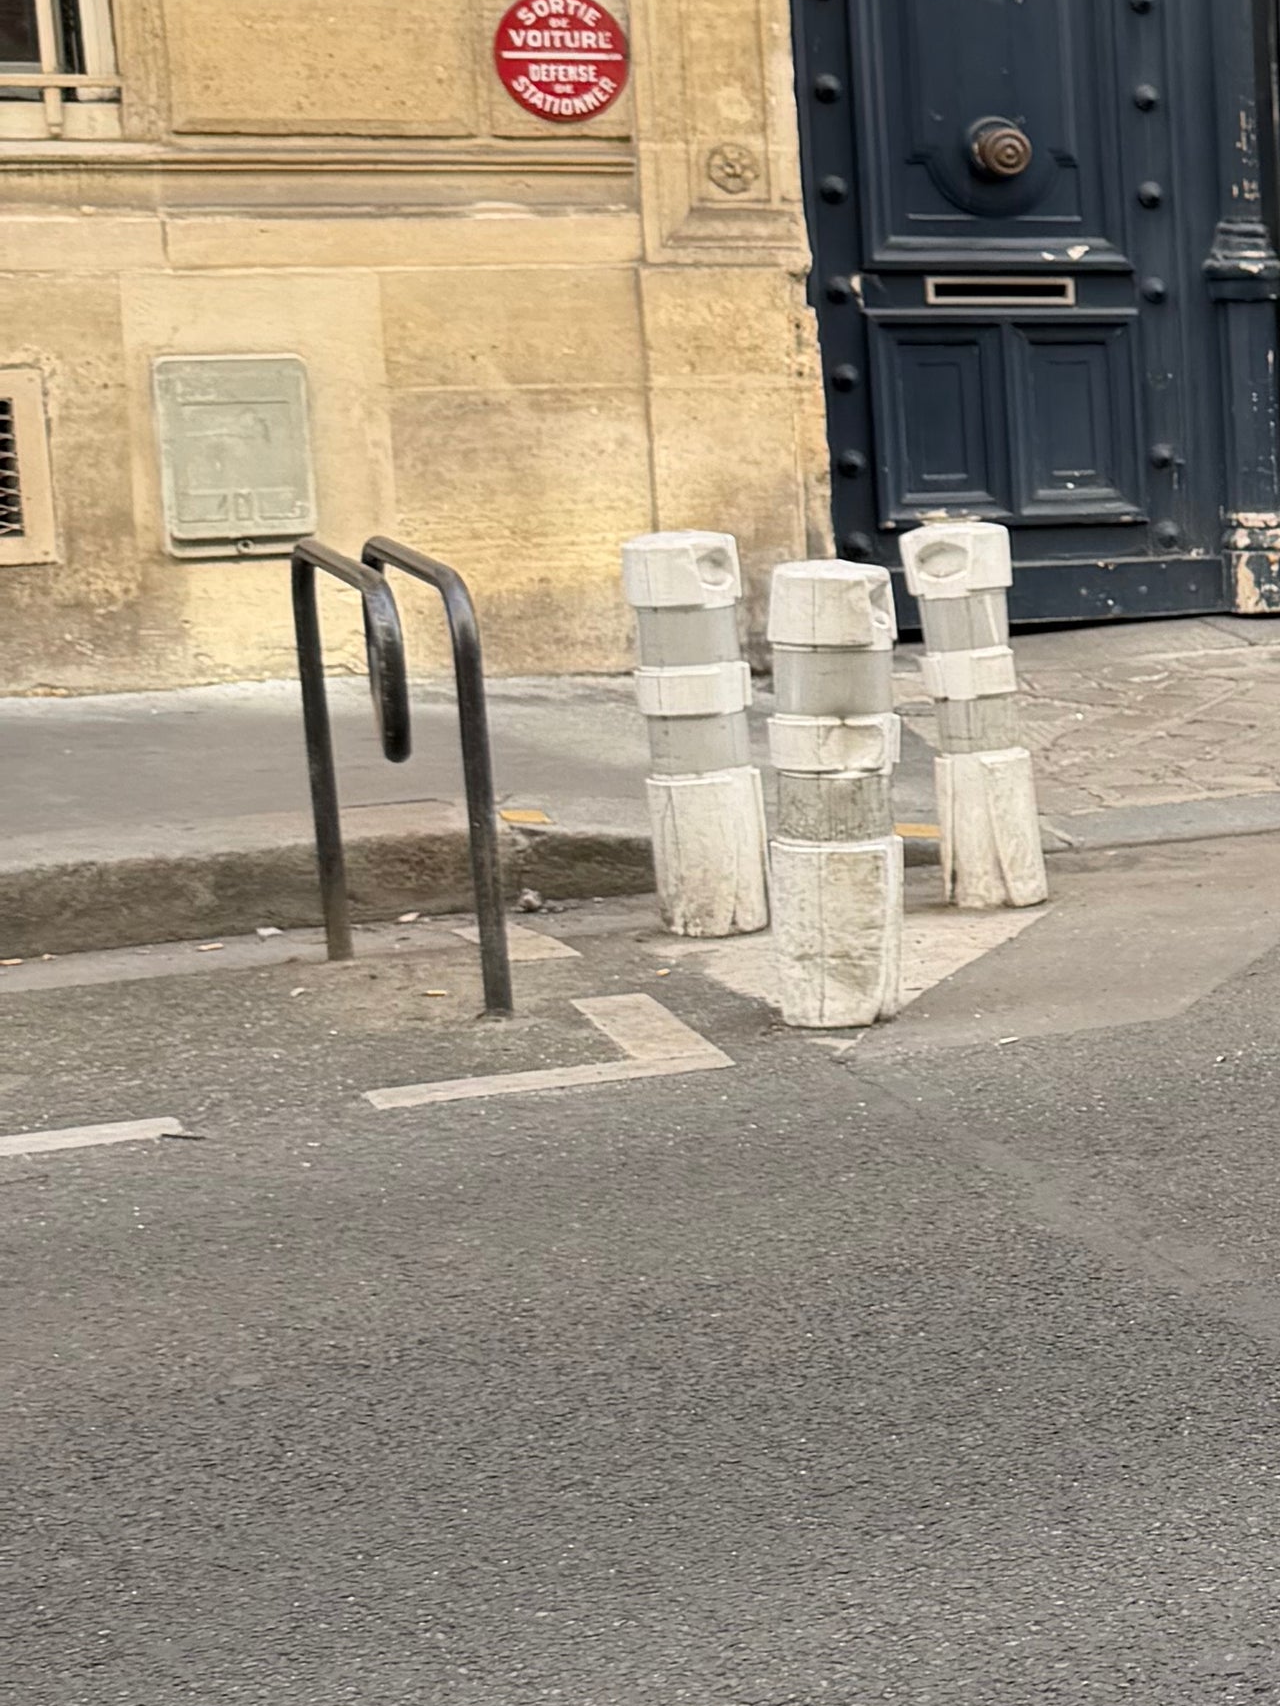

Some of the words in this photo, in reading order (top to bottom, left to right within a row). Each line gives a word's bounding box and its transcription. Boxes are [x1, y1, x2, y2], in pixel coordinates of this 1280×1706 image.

[548, 17, 571, 28] DE
[507, 28, 613, 49] VOITURE
[511, 75, 618, 116] STATIONNER
[552, 83, 575, 94] DE
